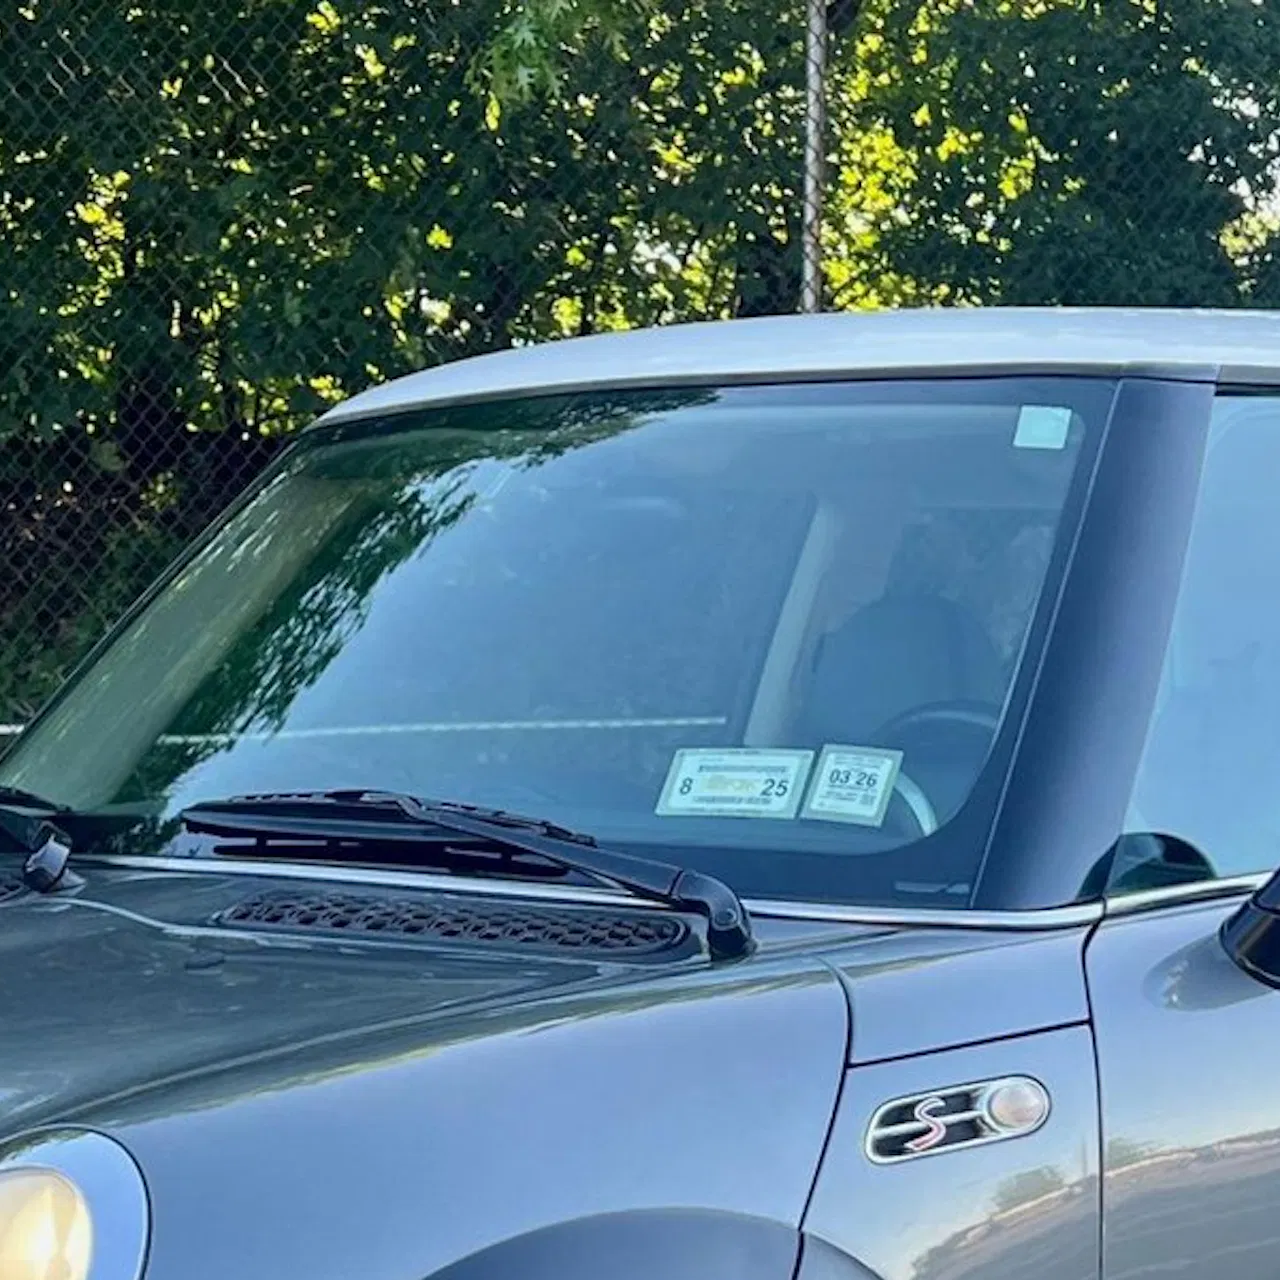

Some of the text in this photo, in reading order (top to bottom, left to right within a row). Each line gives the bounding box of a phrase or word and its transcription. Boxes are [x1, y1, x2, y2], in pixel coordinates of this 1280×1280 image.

[679, 776, 789, 797] 8 25
[828, 768, 879, 788] 03 26
[904, 1096, 947, 1151] S
